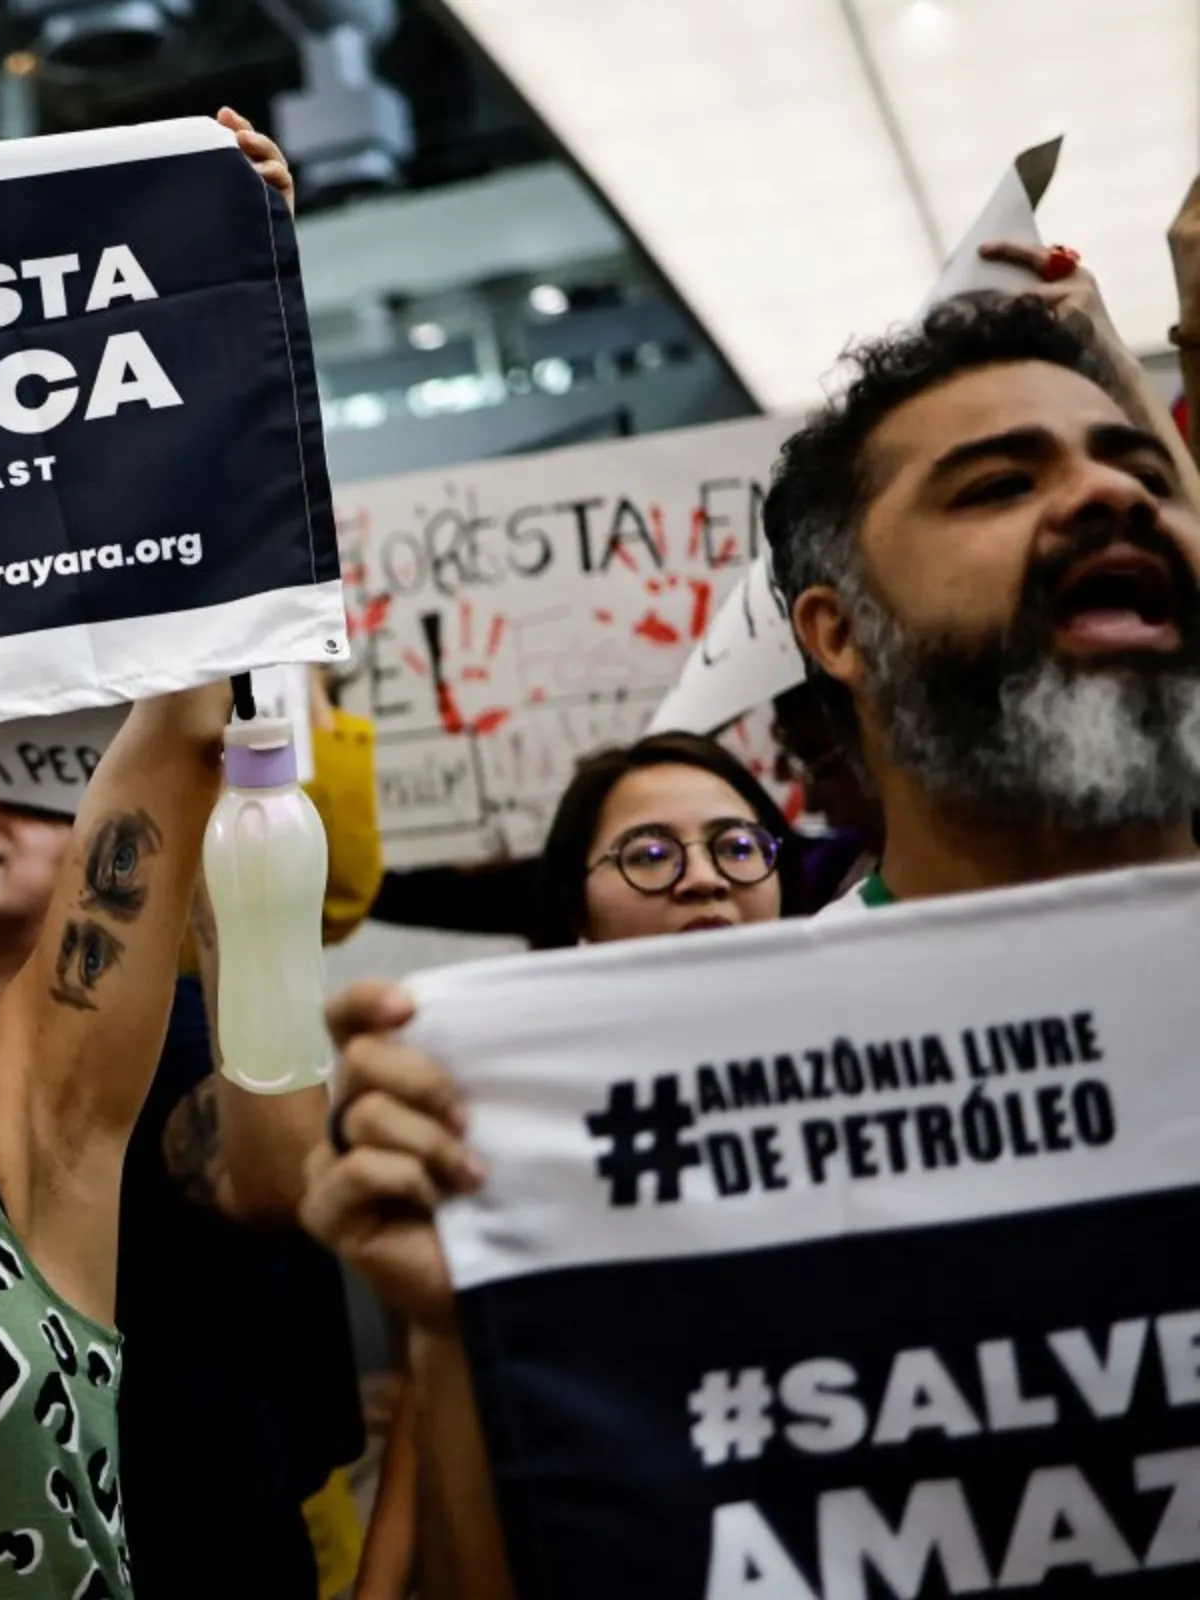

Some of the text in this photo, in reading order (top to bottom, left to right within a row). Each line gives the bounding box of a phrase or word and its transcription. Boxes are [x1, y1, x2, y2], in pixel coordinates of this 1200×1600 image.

[961, 1011, 1105, 1080] LIVRE
[704, 1079, 1116, 1198] DE PETRÓLEO
